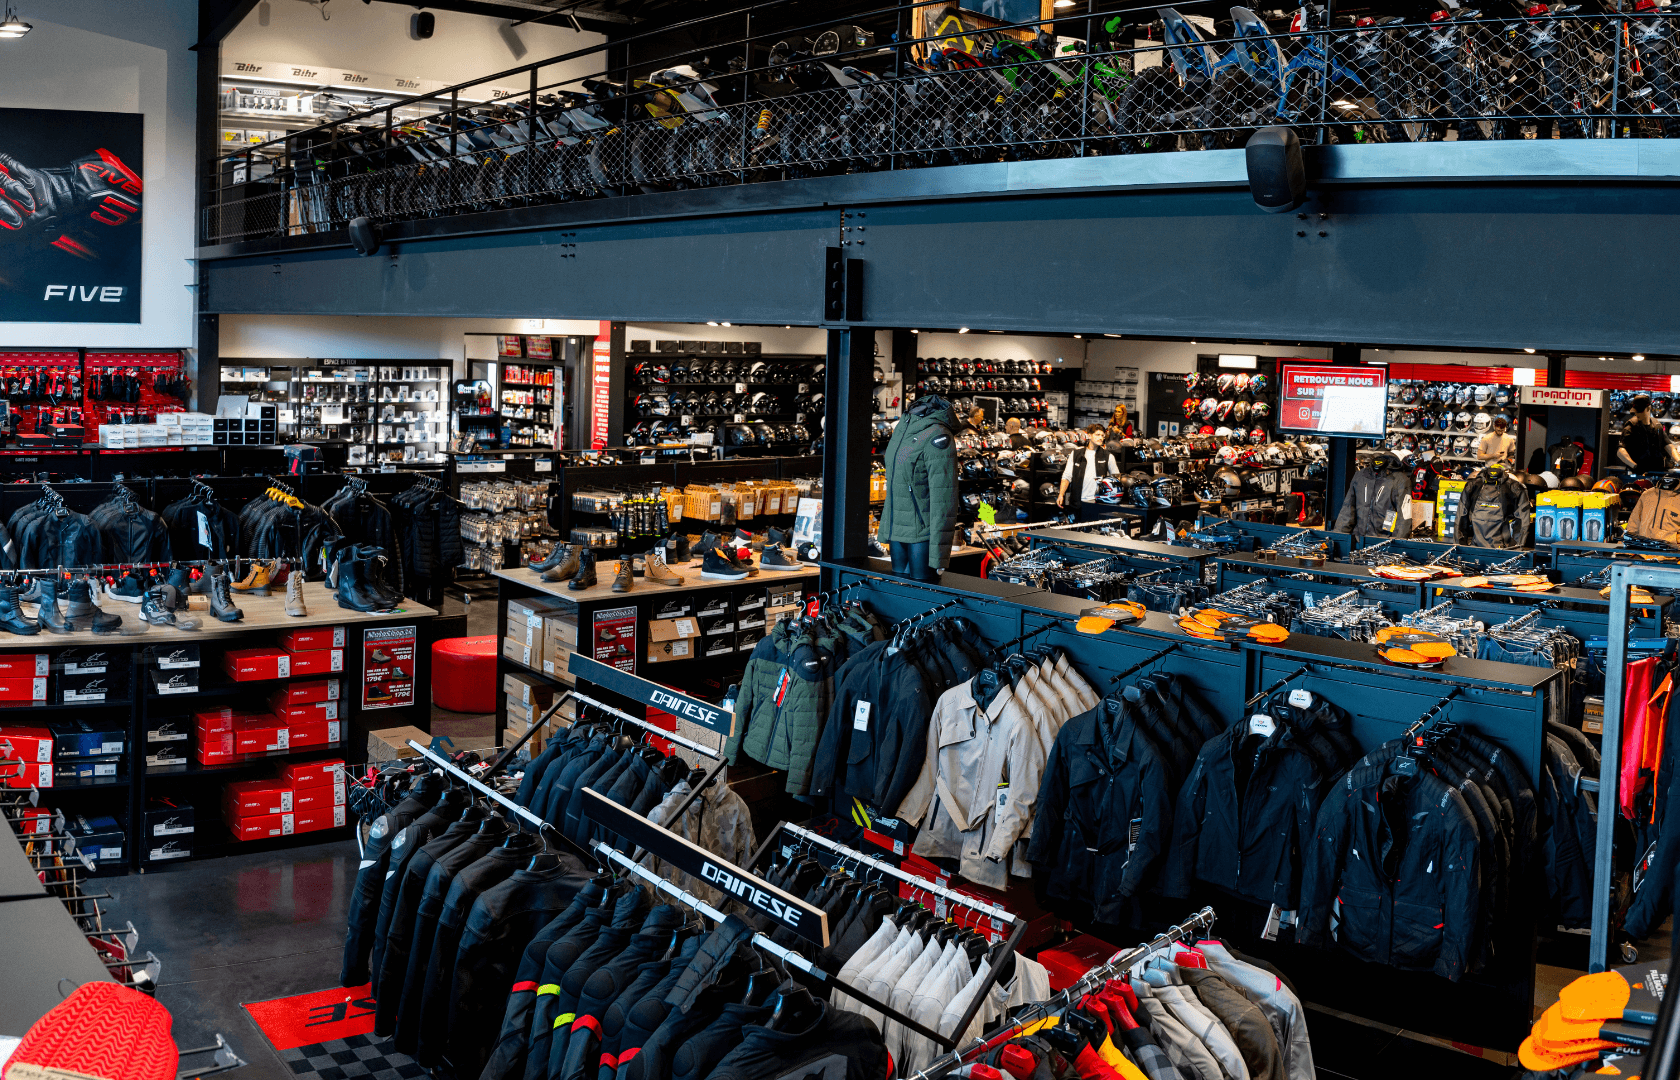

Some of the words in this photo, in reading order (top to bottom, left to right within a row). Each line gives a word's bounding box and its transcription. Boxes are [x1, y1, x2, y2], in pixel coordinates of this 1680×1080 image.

[235, 62, 262, 73] Bihr
[292, 68, 318, 79] Bihr
[342, 73, 368, 83] Bihr
[394, 78, 421, 89] Bihr
[78, 162, 144, 196] FIVE
[43, 284, 124, 302] FIVE
[1293, 375, 1346, 385] RETROUVEZ
[1347, 377, 1374, 386] NOUS
[1296, 387, 1315, 396] SUR
[649, 689, 720, 725] DAINESE
[700, 861, 802, 927] DAINESE
[1616, 1036, 1650, 1046] www.furygan.co
